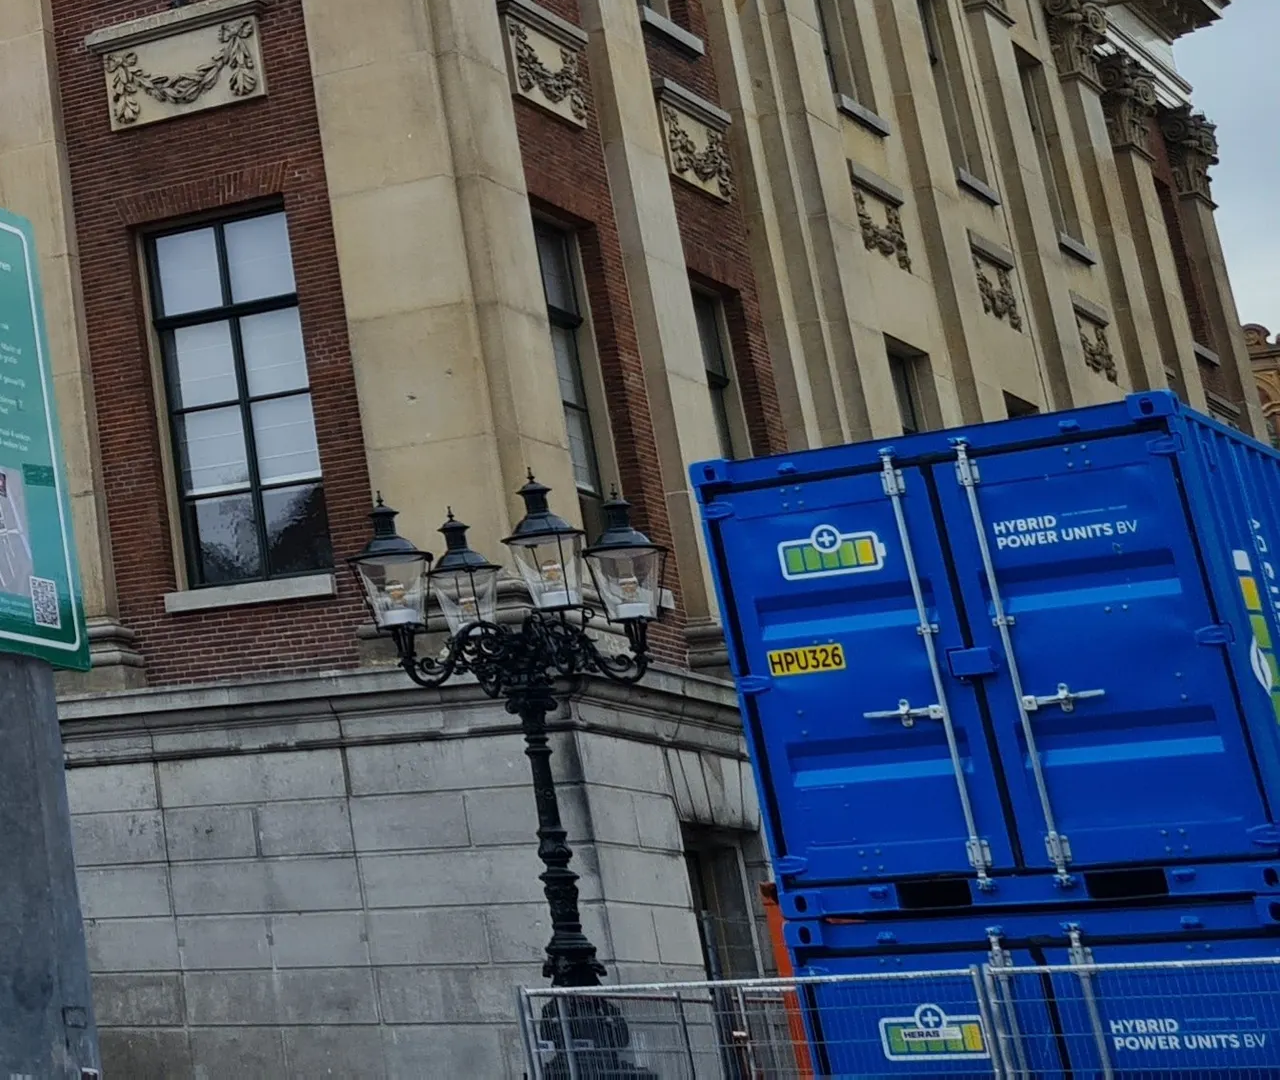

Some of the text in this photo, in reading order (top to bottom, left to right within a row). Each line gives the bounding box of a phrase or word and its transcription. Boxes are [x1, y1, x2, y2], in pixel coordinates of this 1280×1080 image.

[993, 515, 1057, 535] HYBRID
[996, 519, 1138, 550] POWER UNITS BV
[769, 647, 842, 673] HPU326
[903, 1030, 940, 1039] HERAS
[1109, 1018, 1179, 1034] HYBRID
[1113, 1033, 1266, 1051] POWER UNITS BV
